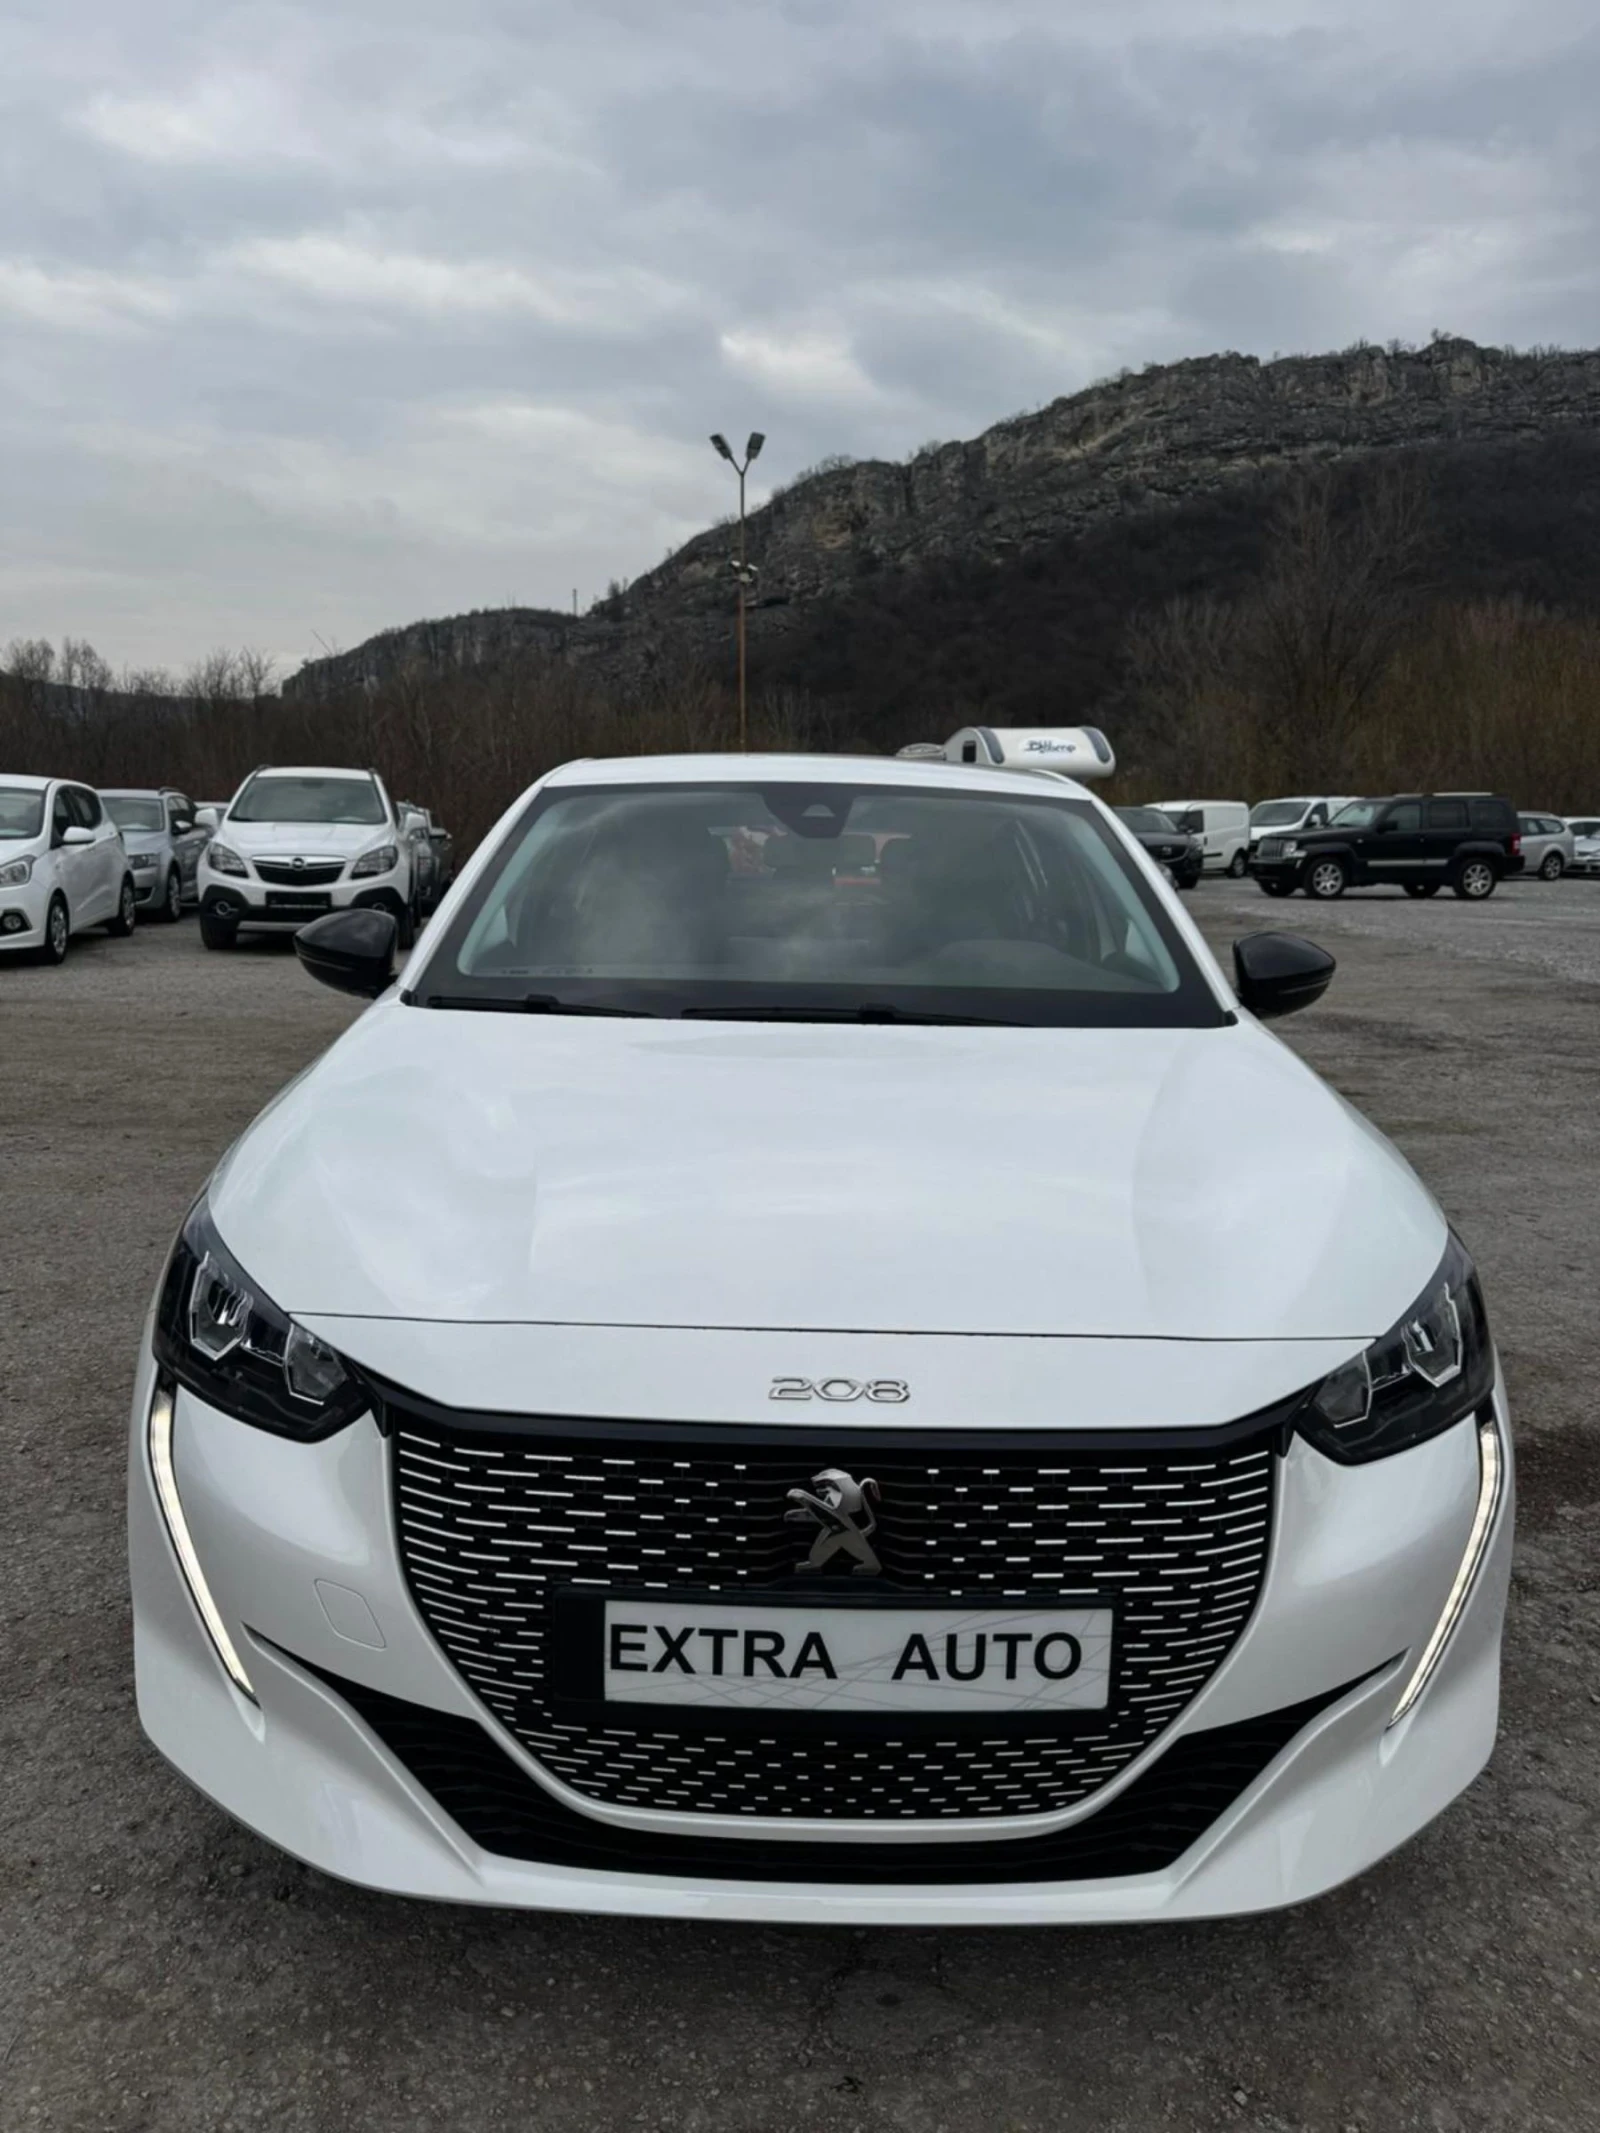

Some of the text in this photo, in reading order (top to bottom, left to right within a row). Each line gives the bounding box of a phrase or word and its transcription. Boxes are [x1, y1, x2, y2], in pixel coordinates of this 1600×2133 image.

[769, 1378, 910, 1403] 208
[609, 1623, 1082, 1681] EXTRA AUTO
